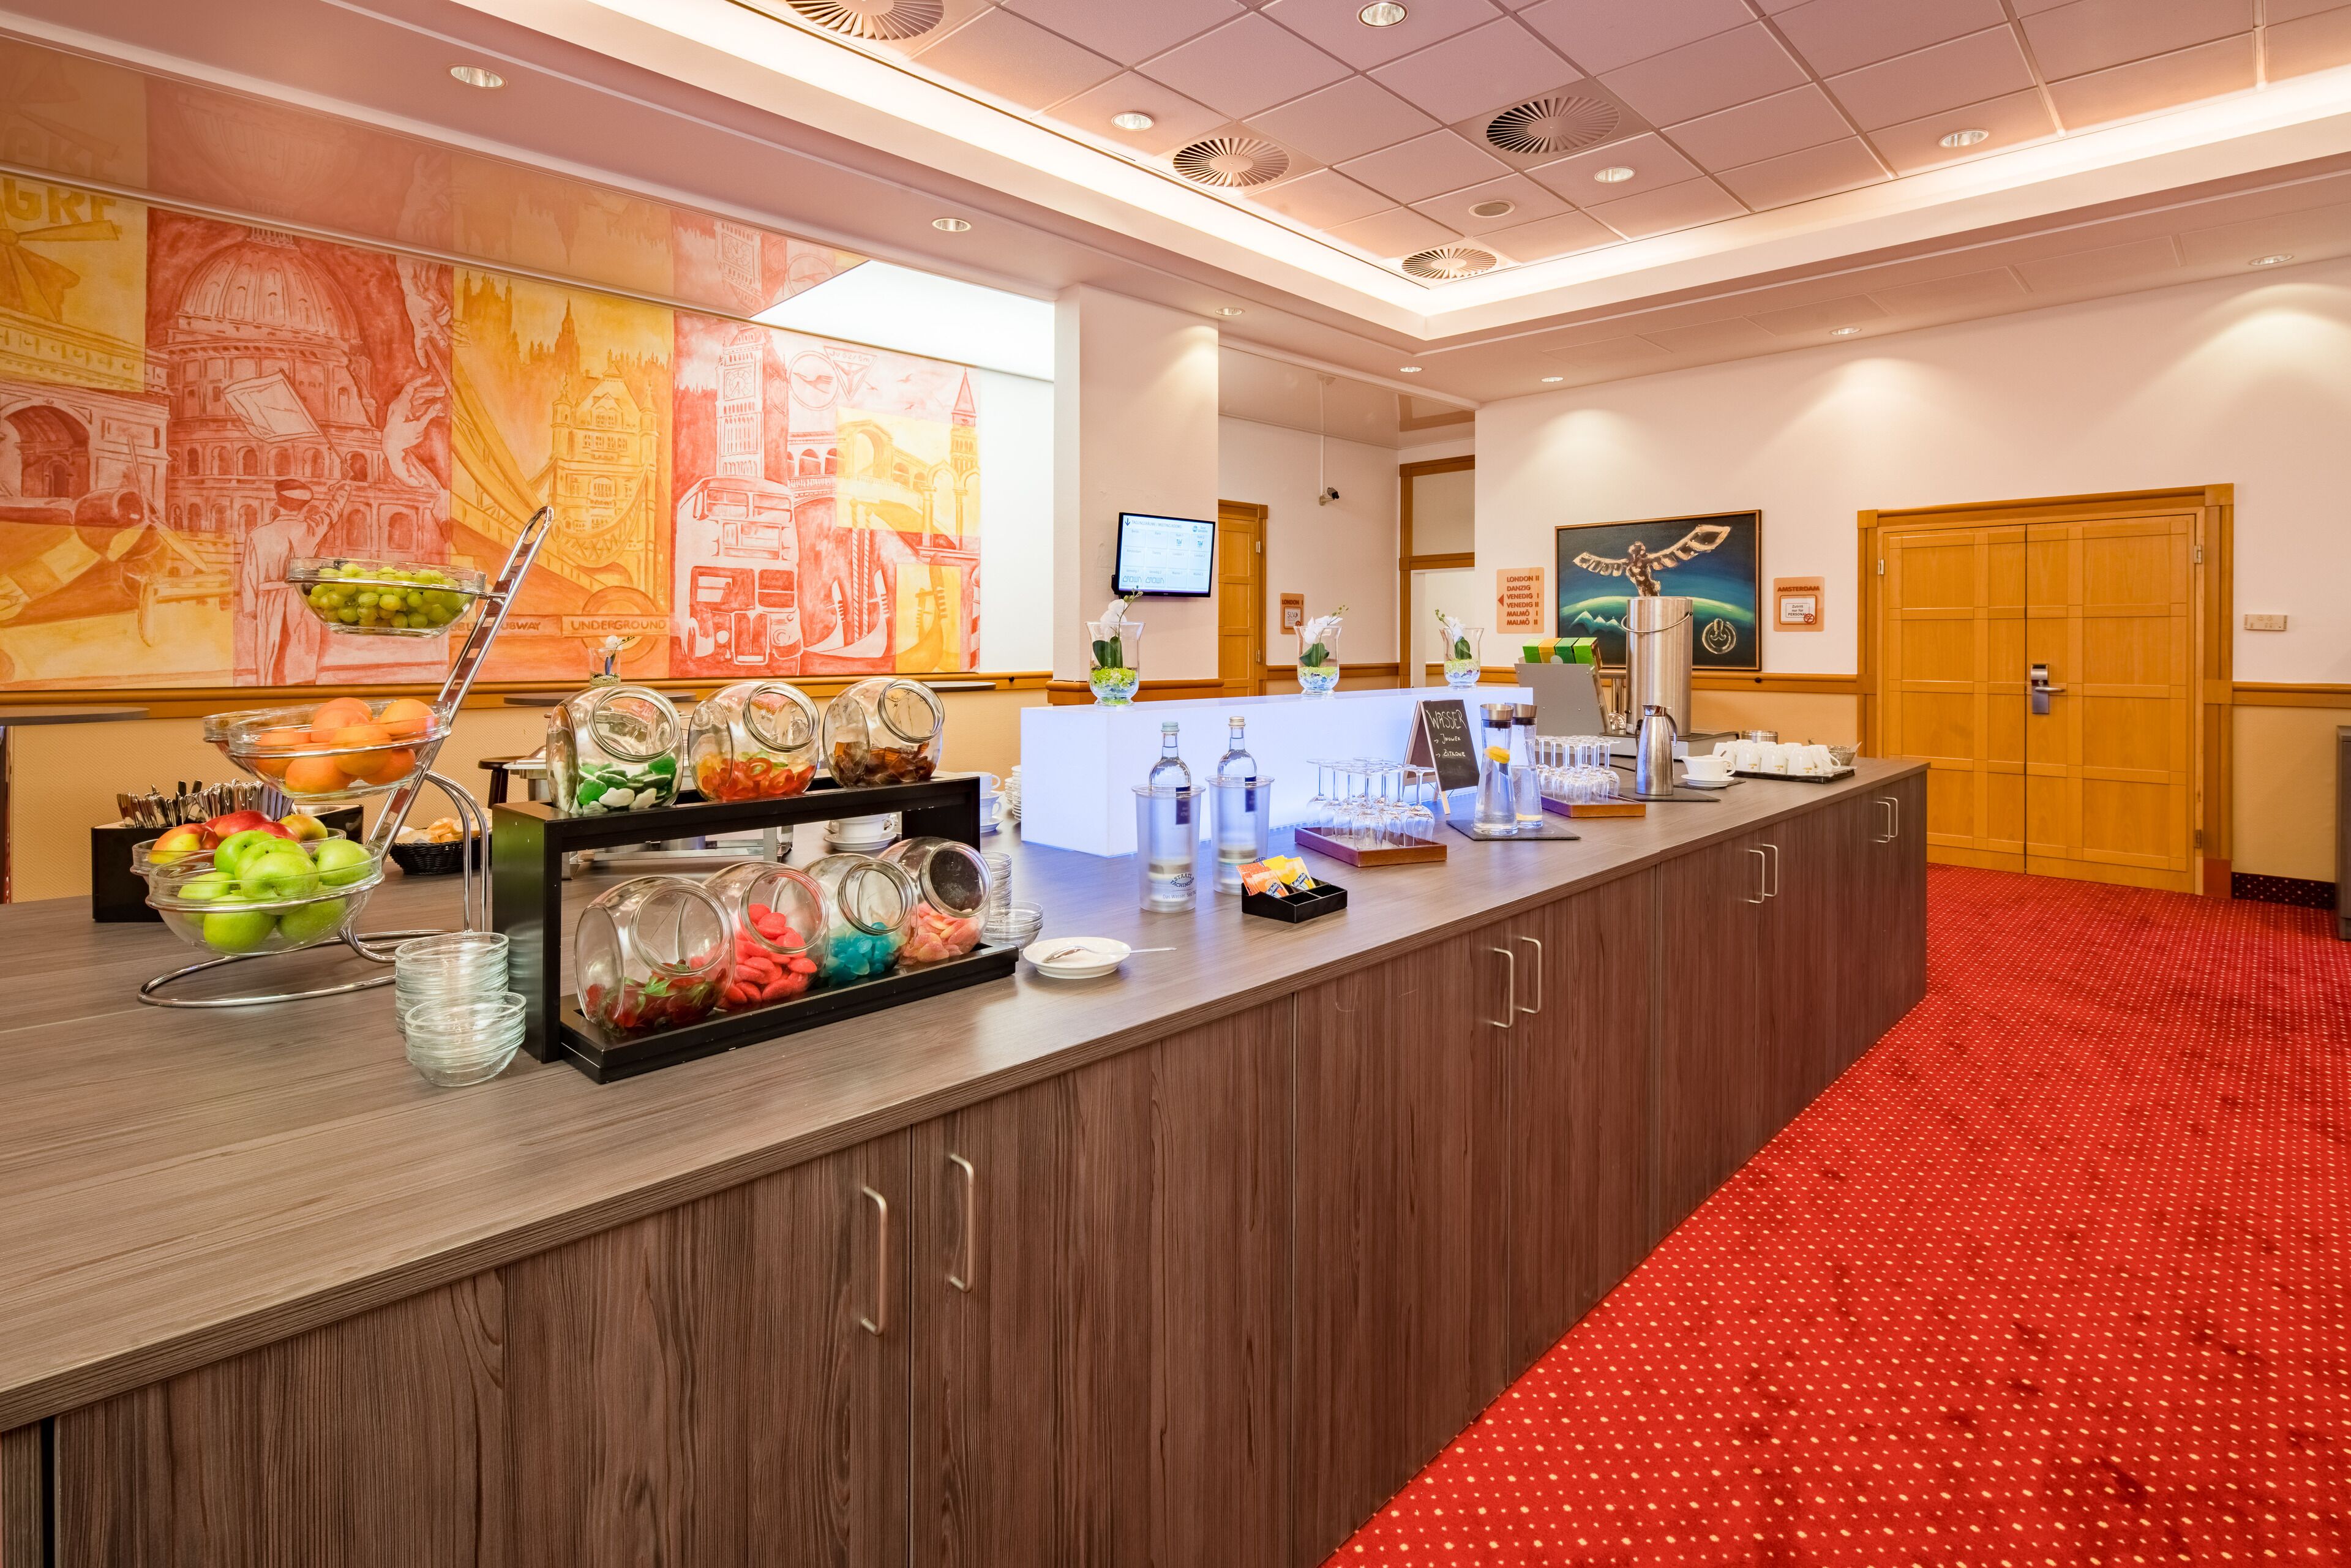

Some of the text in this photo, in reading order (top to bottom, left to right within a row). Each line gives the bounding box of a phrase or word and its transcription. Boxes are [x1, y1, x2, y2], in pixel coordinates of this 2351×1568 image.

[501, 621, 541, 631] UBWAY
[571, 620, 667, 631] UNDERGROUND
[1425, 709, 1467, 729] WASSER
